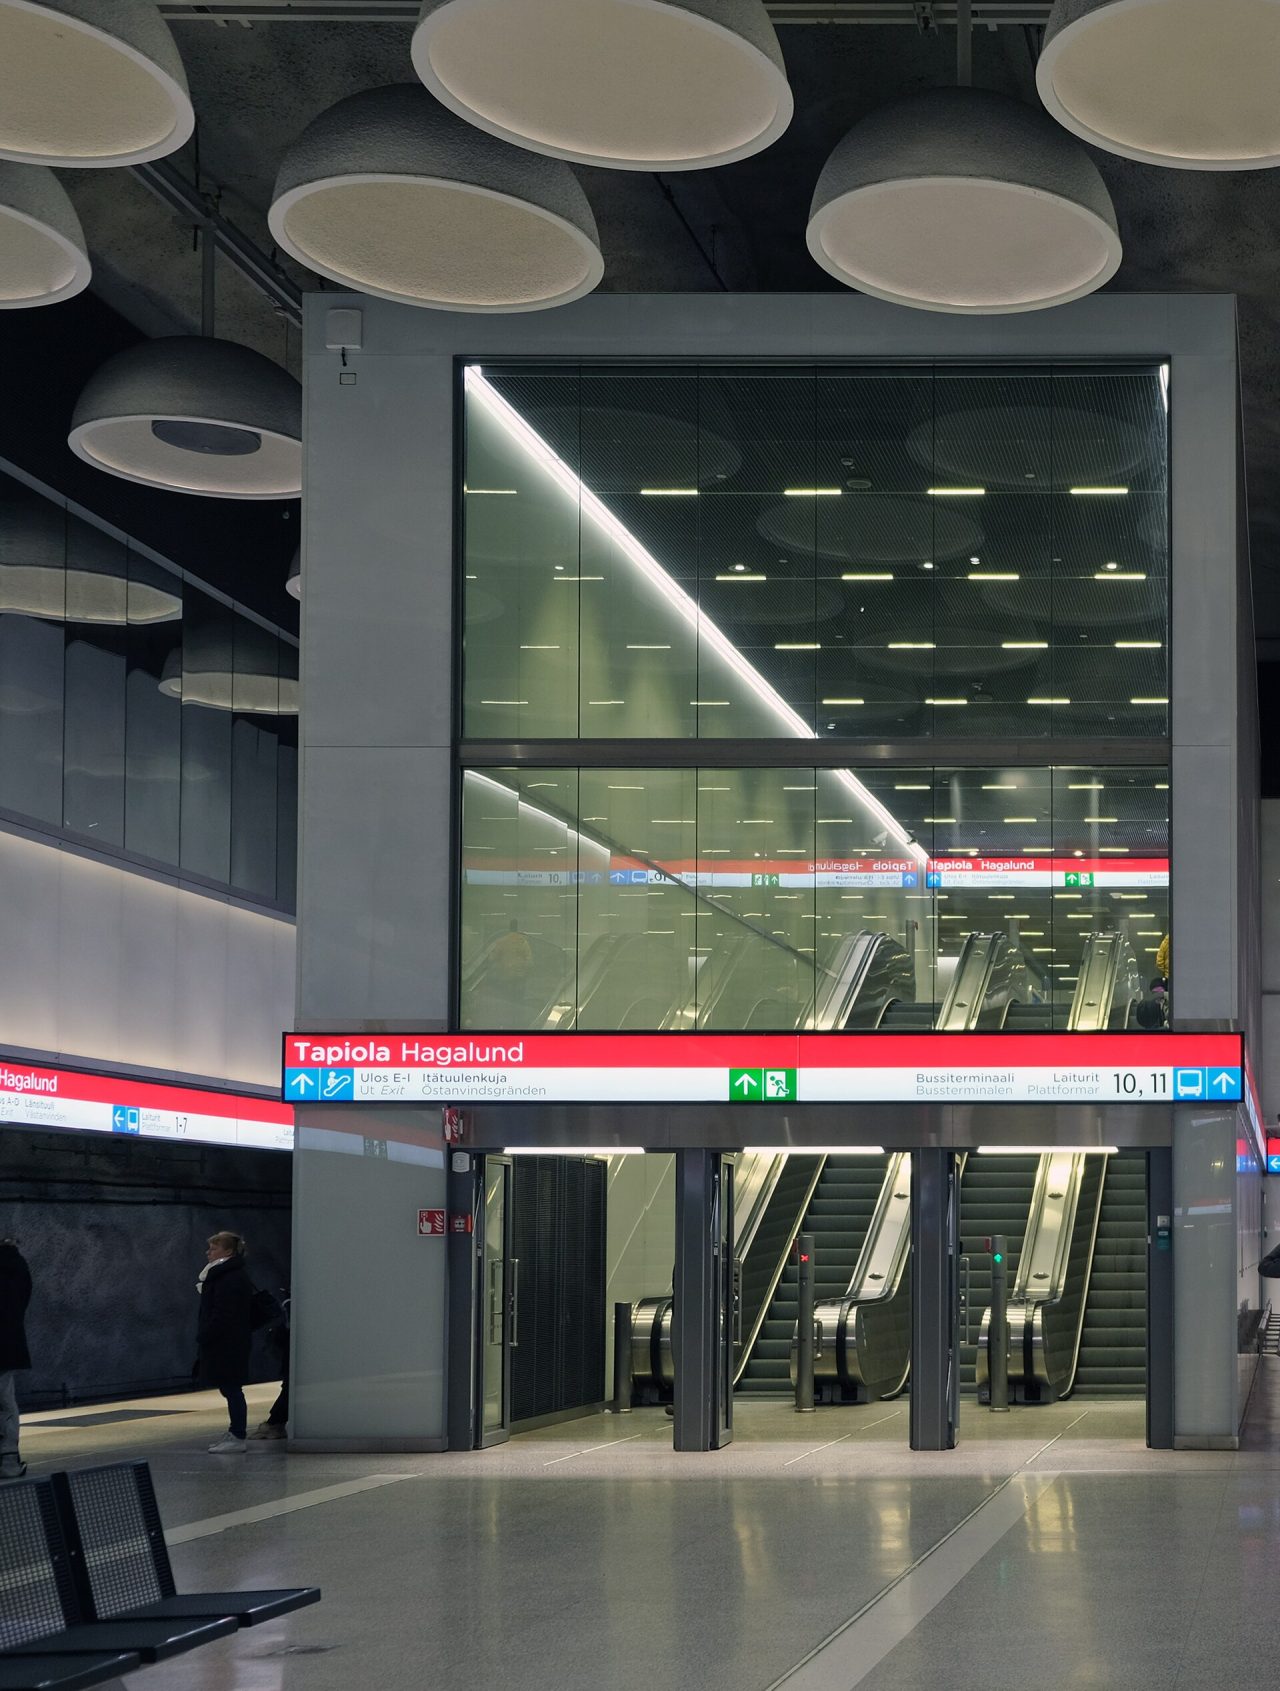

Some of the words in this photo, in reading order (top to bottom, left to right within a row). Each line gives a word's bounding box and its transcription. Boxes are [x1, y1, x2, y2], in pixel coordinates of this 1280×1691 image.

[930, 861, 973, 872] Tapiola
[981, 861, 1035, 872] Hagalund
[293, 1041, 391, 1066] Tapiola
[401, 1041, 524, 1066] Hagalund
[0, 1067, 58, 1092] Hagalund
[360, 1072, 389, 1083] Ulos
[393, 1072, 411, 1083] E-I
[422, 1072, 507, 1085] Itätuulenkuja
[916, 1073, 1015, 1084] Bussiterminaali
[1053, 1072, 1100, 1083] Laiturit
[916, 1085, 1014, 1096] Bussterminalen
[1027, 1084, 1100, 1096] Plattformar
[1113, 1072, 1143, 1097] 10,
[1150, 1072, 1167, 1094] 11
[360, 1085, 375, 1096] Ut
[380, 1085, 405, 1096] Exit
[421, 1084, 547, 1098] Östanvindsgränden
